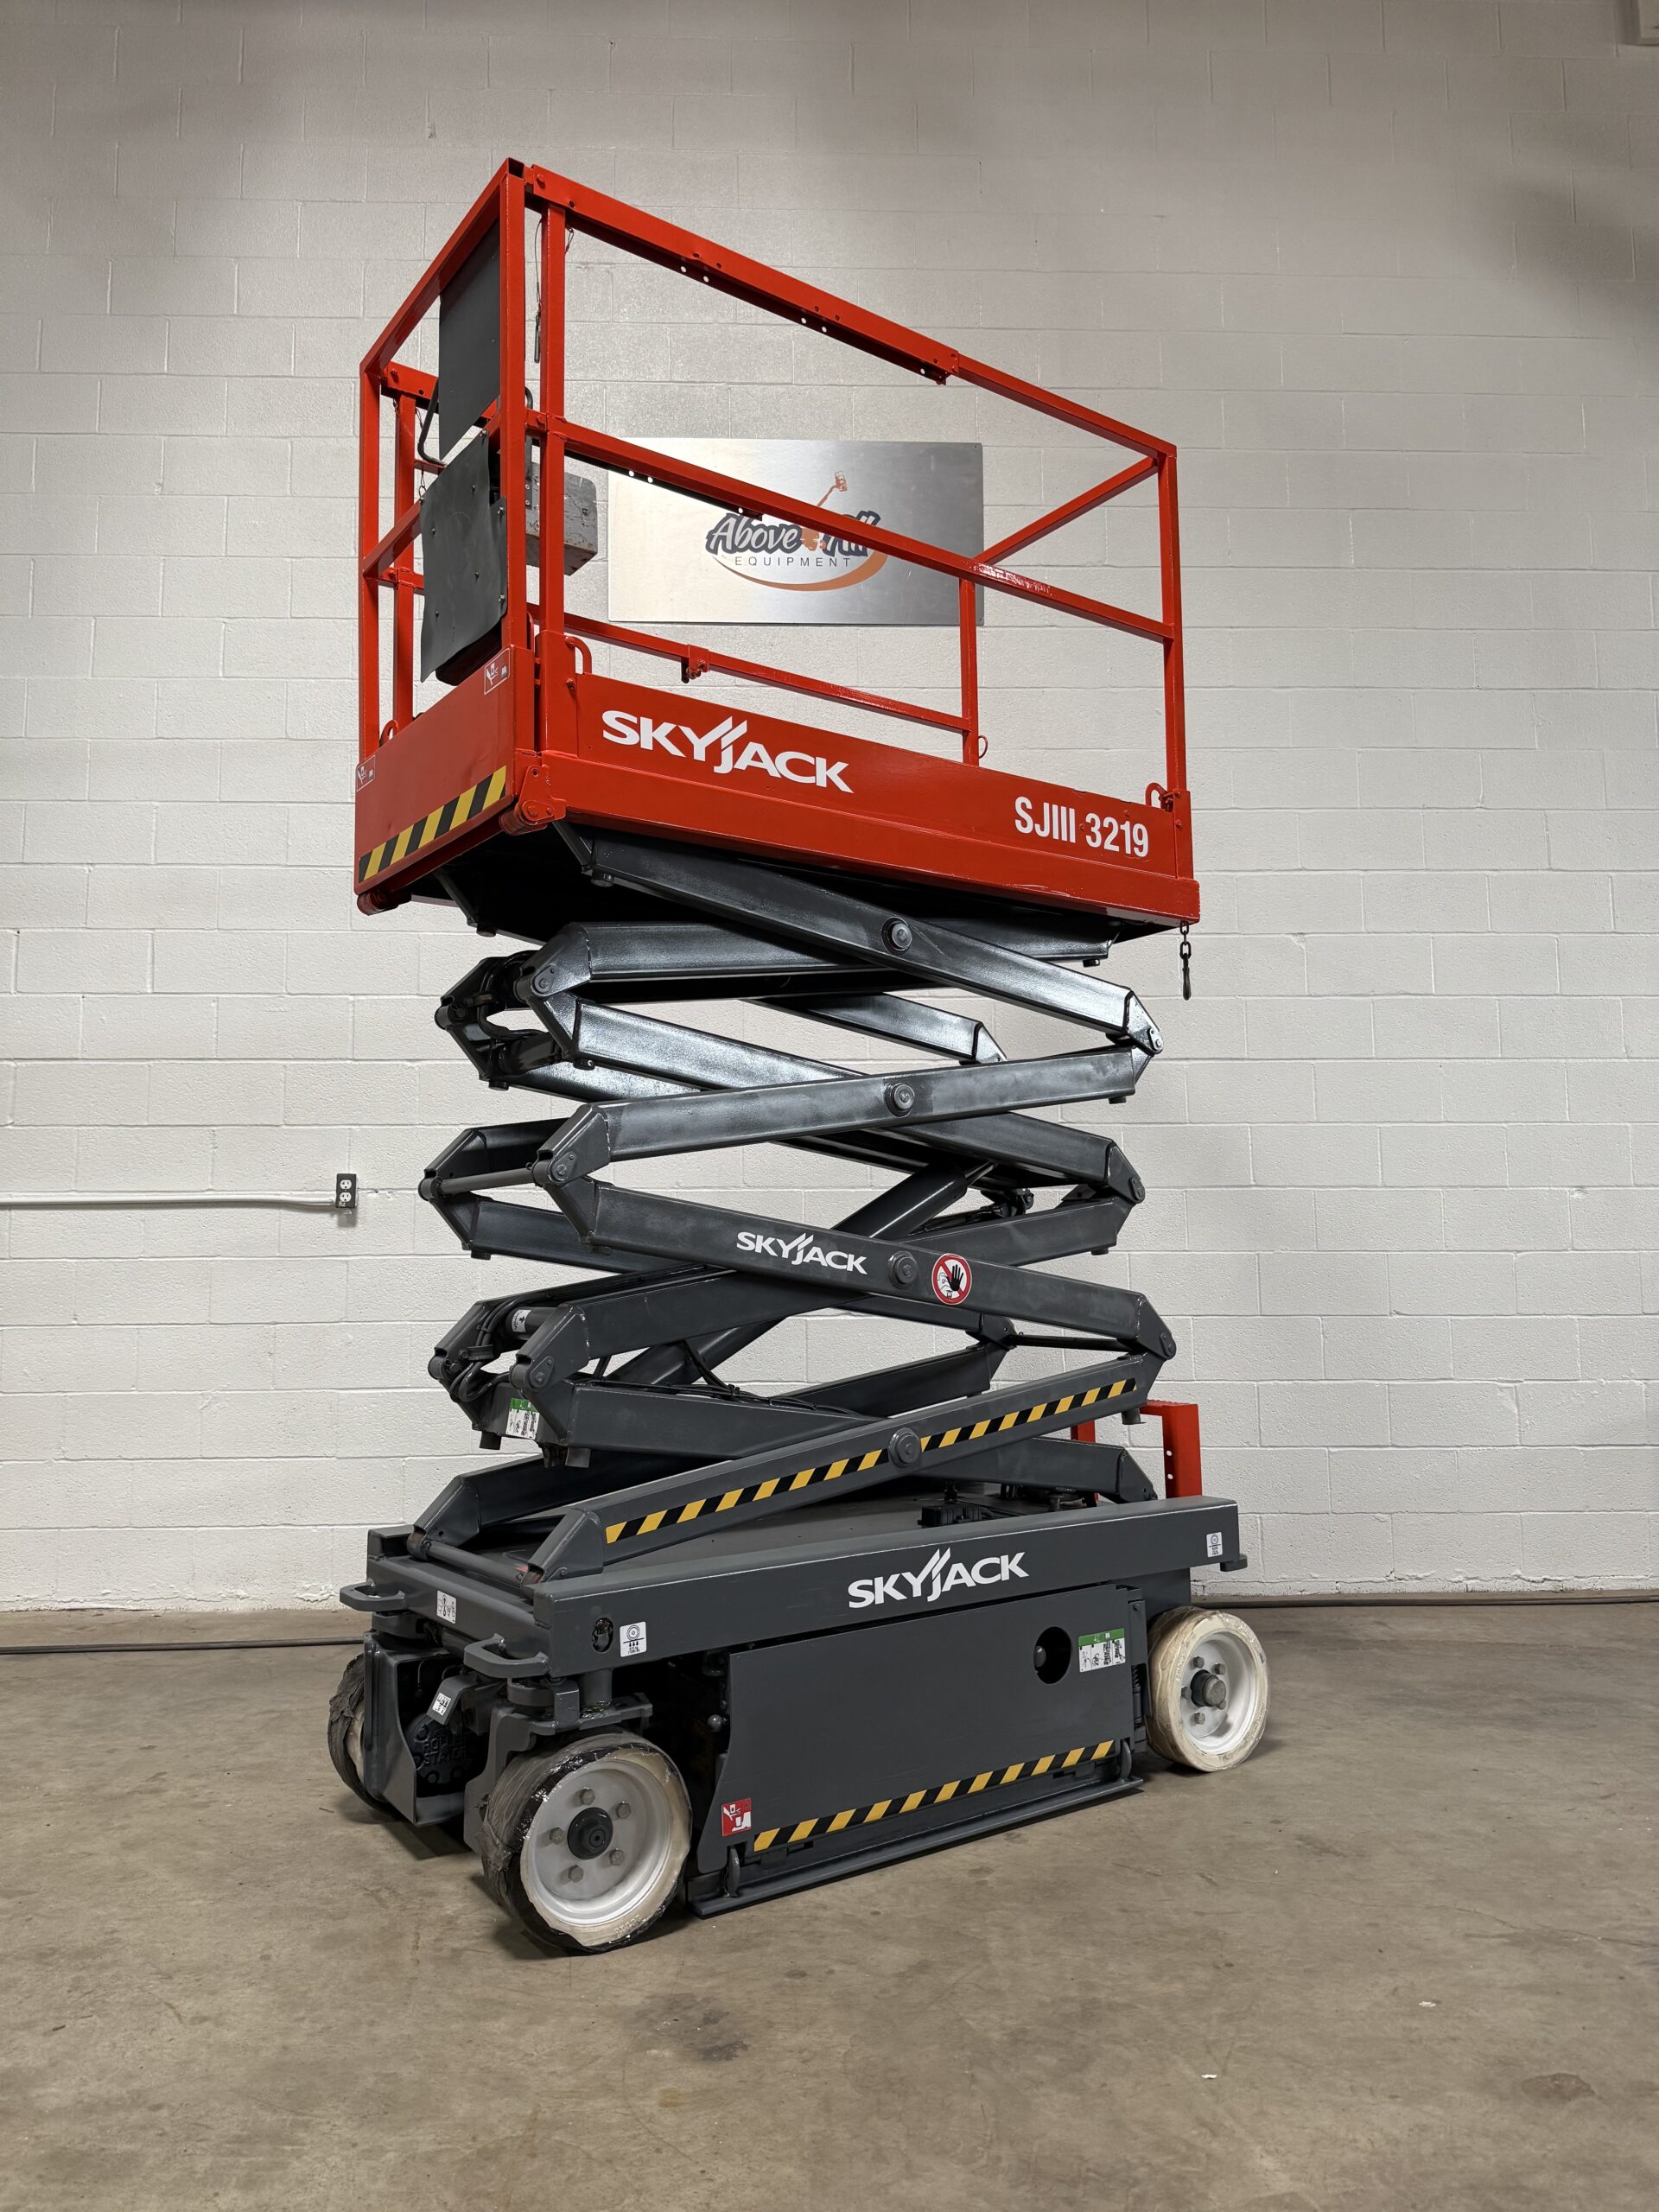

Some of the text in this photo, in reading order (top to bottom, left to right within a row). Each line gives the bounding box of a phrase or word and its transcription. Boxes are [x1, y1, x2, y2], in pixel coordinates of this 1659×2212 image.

[706, 513, 803, 554] Above
[734, 556, 851, 568] EQUIPMENT
[601, 709, 855, 794] SKYJACK
[1014, 796, 1149, 858] SJIII 3219
[736, 1231, 868, 1275] SKYJACK
[848, 1547, 1030, 1609] SKYJACK
